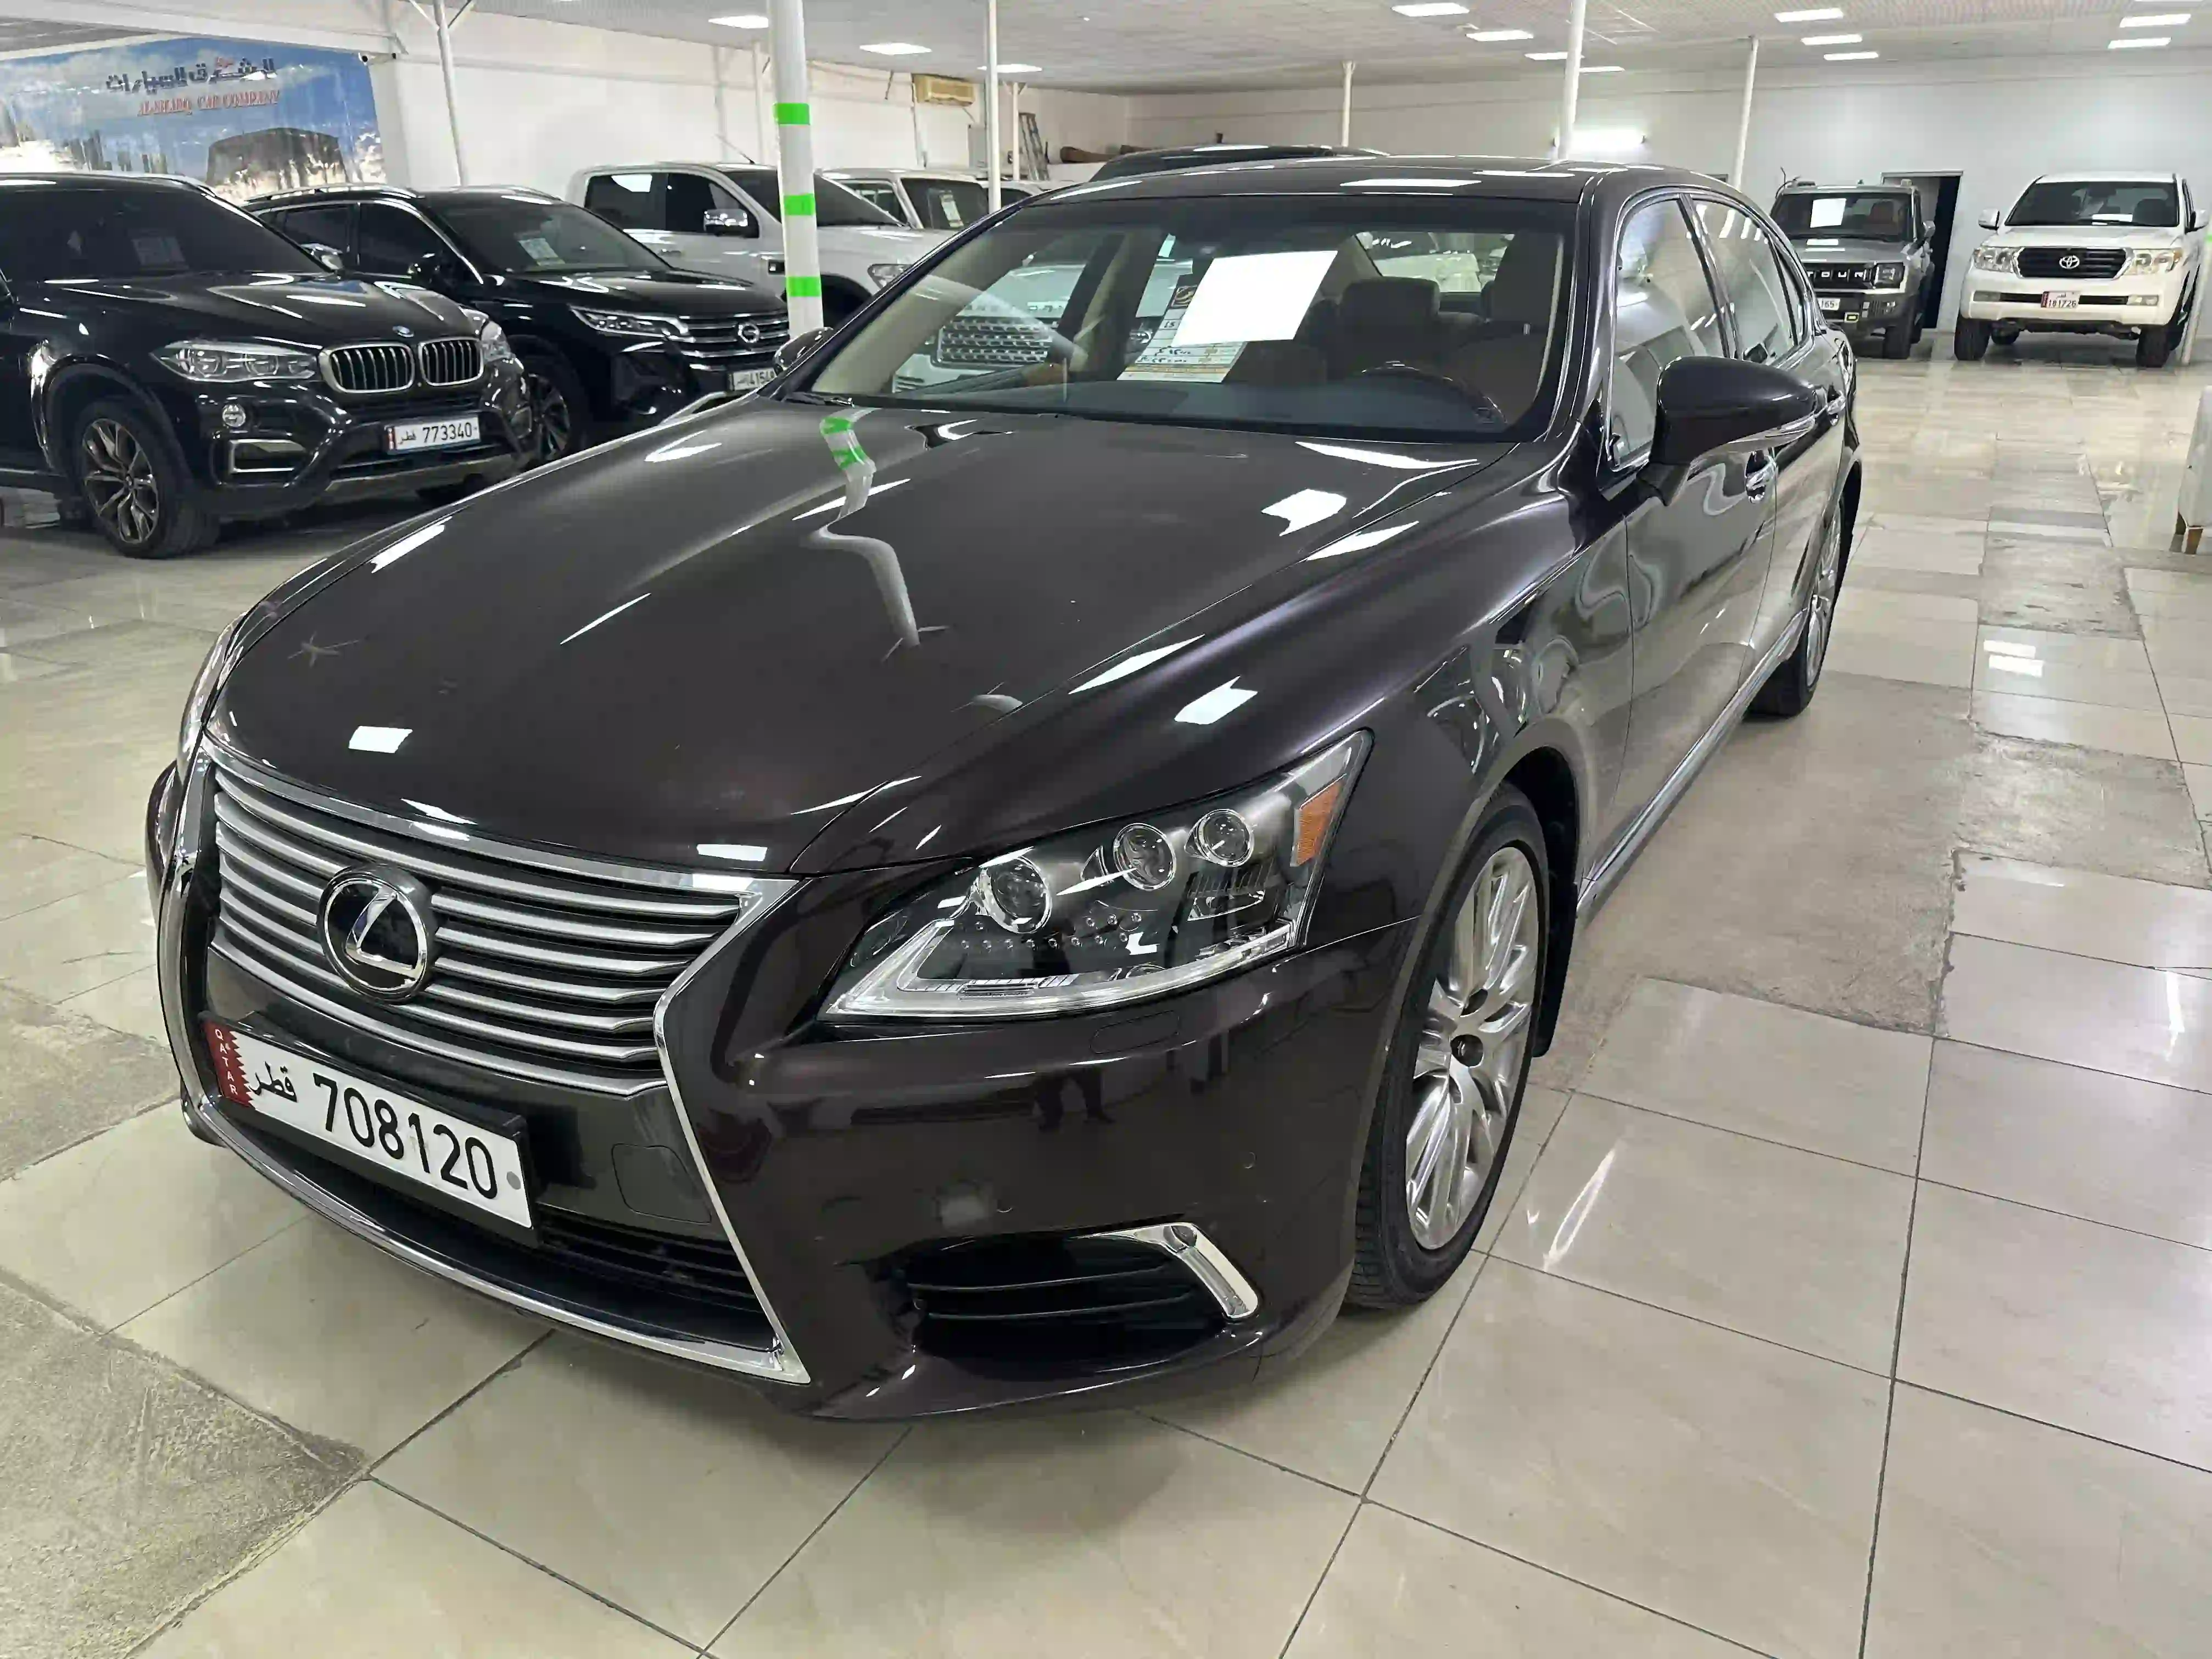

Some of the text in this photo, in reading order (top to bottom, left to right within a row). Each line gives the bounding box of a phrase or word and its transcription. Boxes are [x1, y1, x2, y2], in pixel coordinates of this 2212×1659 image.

[422, 422, 472, 443] 773340
[215, 1029, 238, 1096] QATAR
[248, 1060, 498, 1200] قطر 708120
